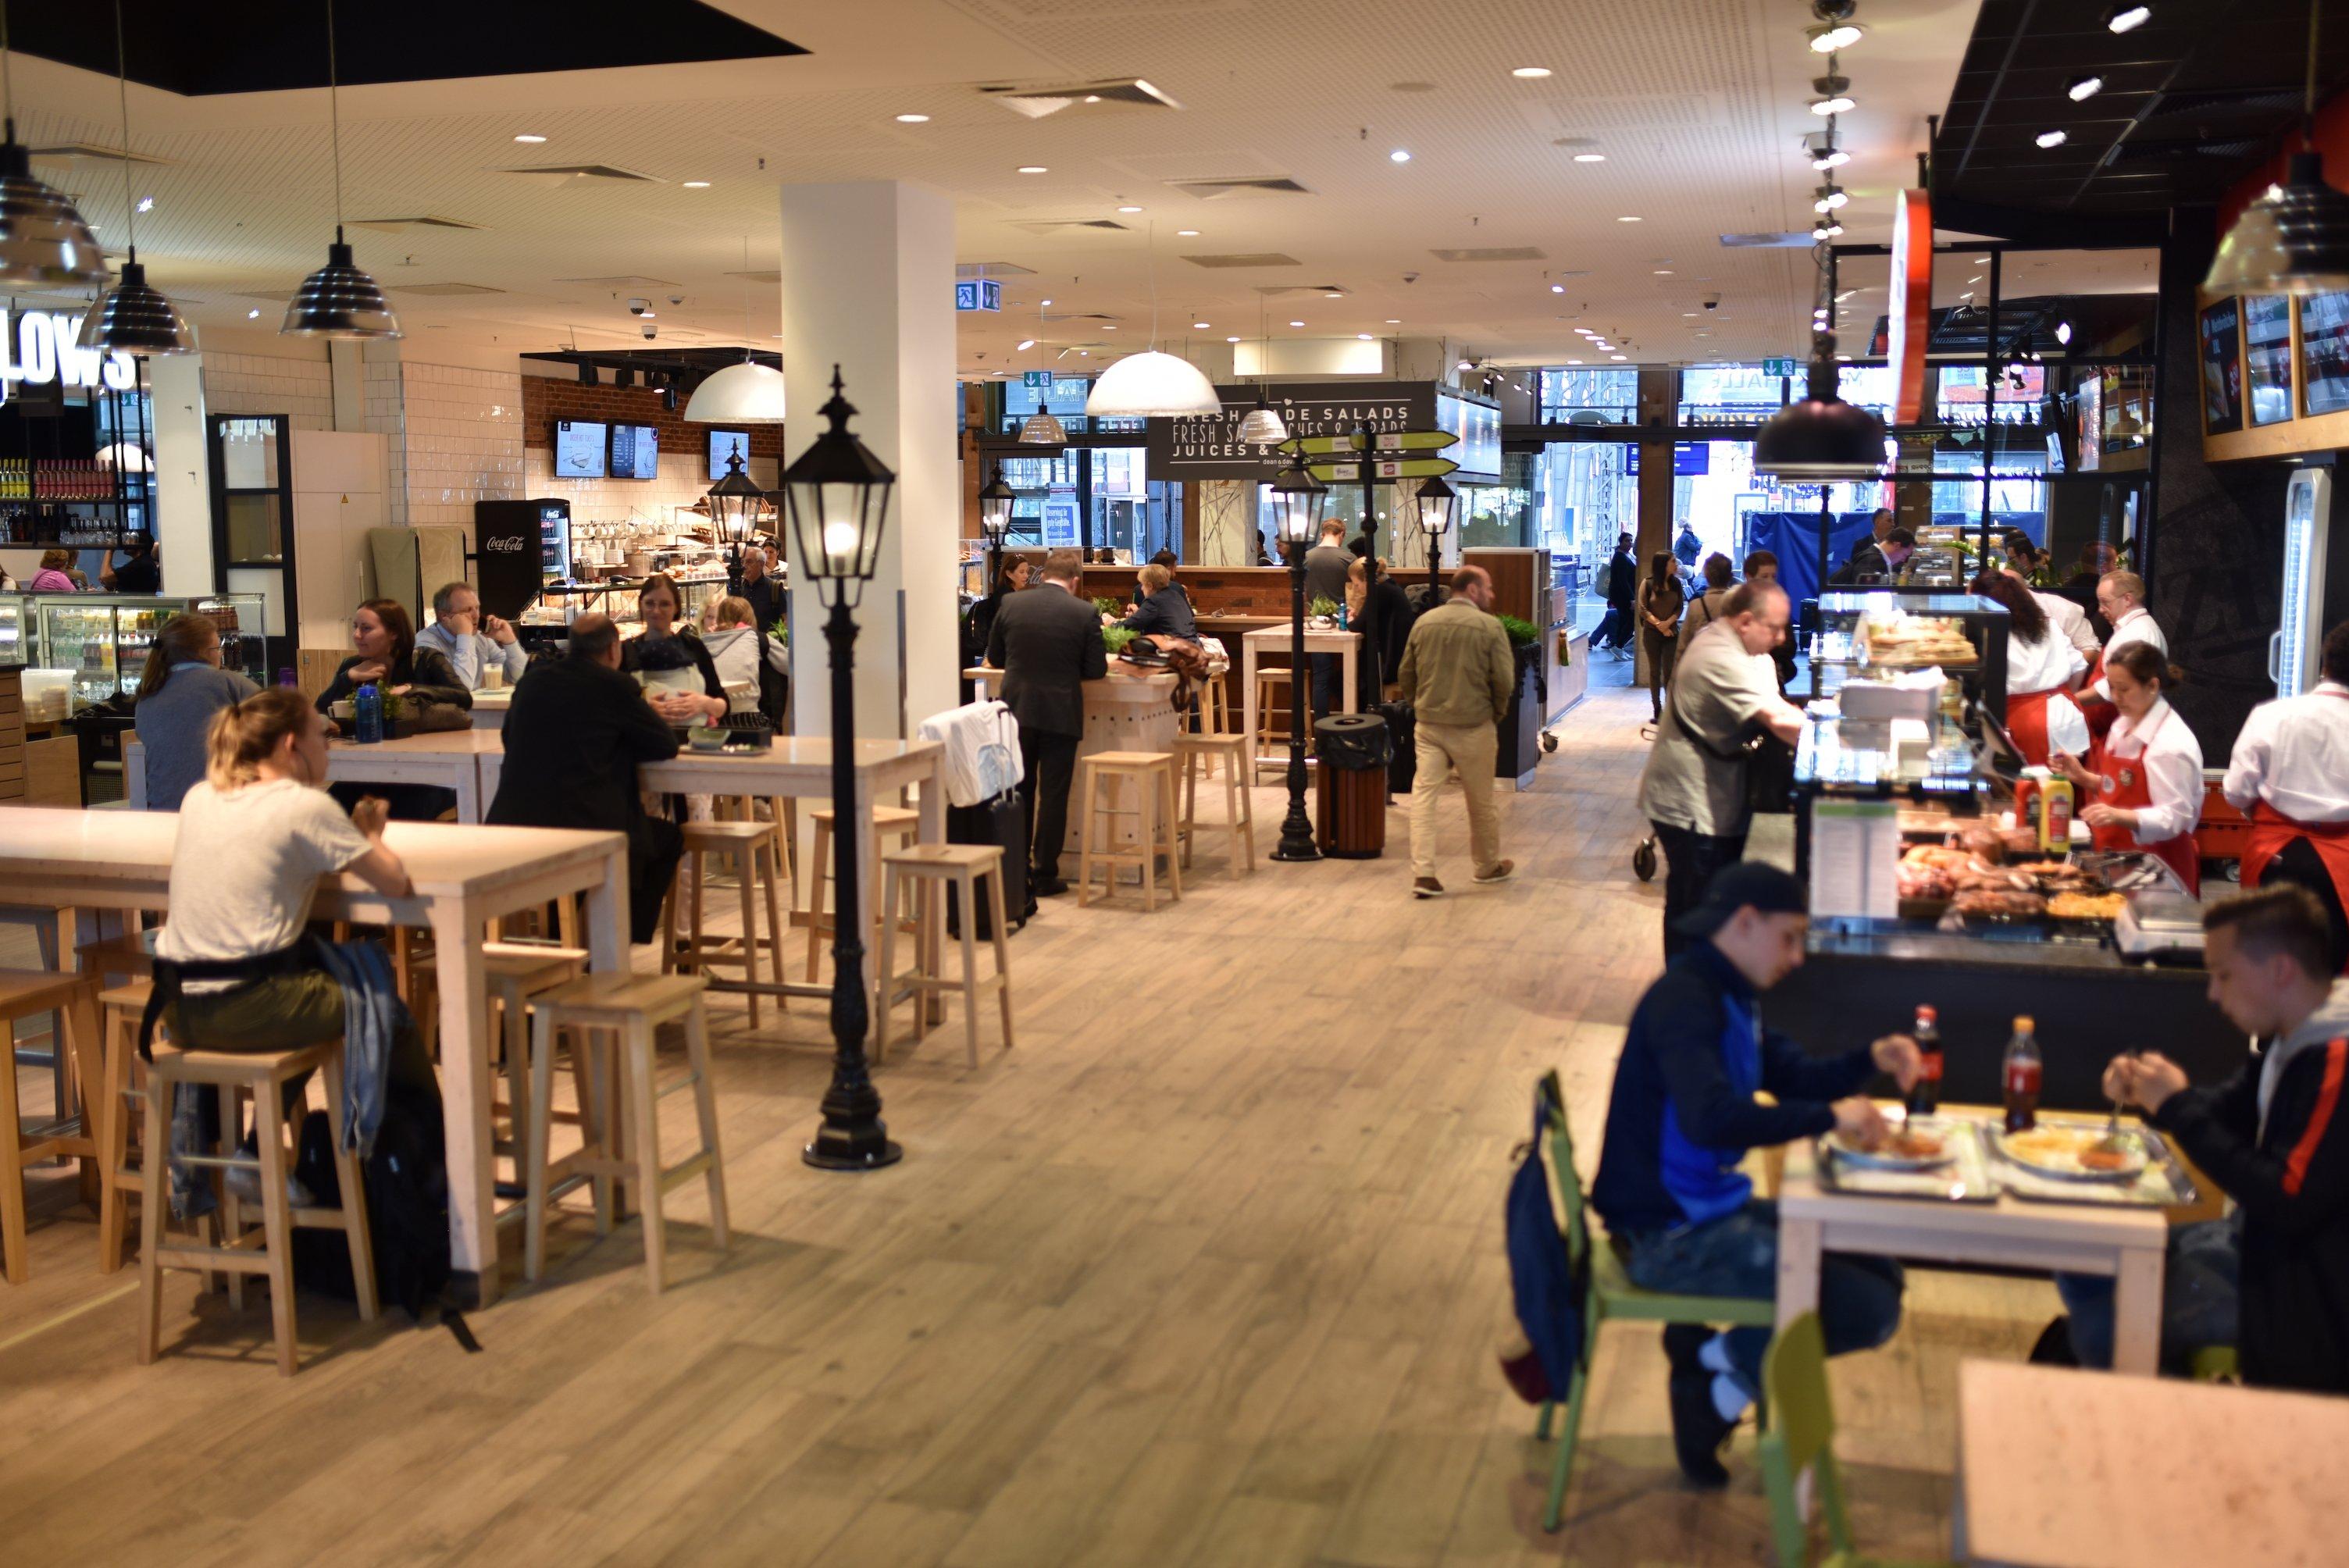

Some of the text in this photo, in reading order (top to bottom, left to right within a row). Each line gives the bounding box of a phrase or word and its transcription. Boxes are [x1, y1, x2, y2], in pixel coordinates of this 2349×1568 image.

[1173, 410, 1239, 422] FRESH
[1324, 407, 1407, 420] SALADS
[1173, 424, 1215, 444] FRESH
[1227, 422, 1323, 443] SACHES
[1172, 444, 1268, 457] JUICES &
